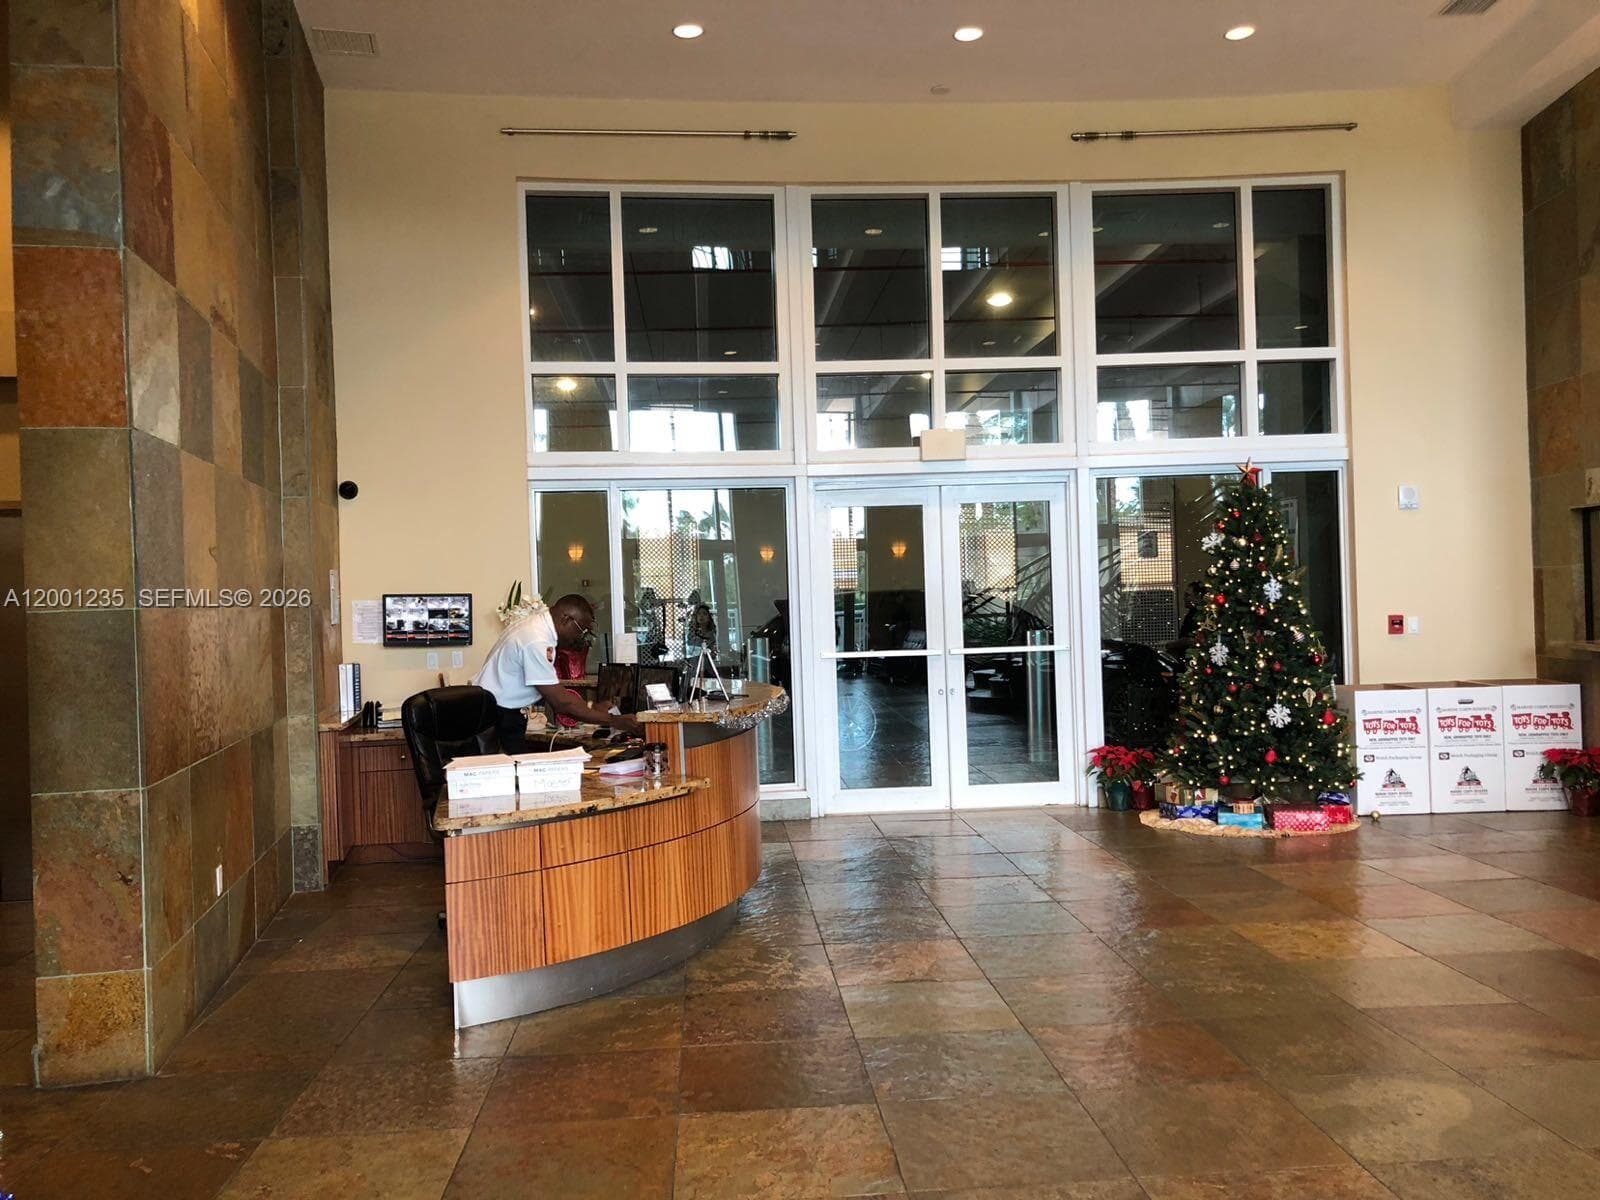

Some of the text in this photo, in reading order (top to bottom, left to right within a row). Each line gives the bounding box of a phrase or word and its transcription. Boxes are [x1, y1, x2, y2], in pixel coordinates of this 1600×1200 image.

[1365, 720, 1417, 731] TOYS FOR TOTS
[1440, 718, 1492, 729] TOYS FOR TOTS
[1514, 714, 1570, 726] TOYS FOR TOTS
